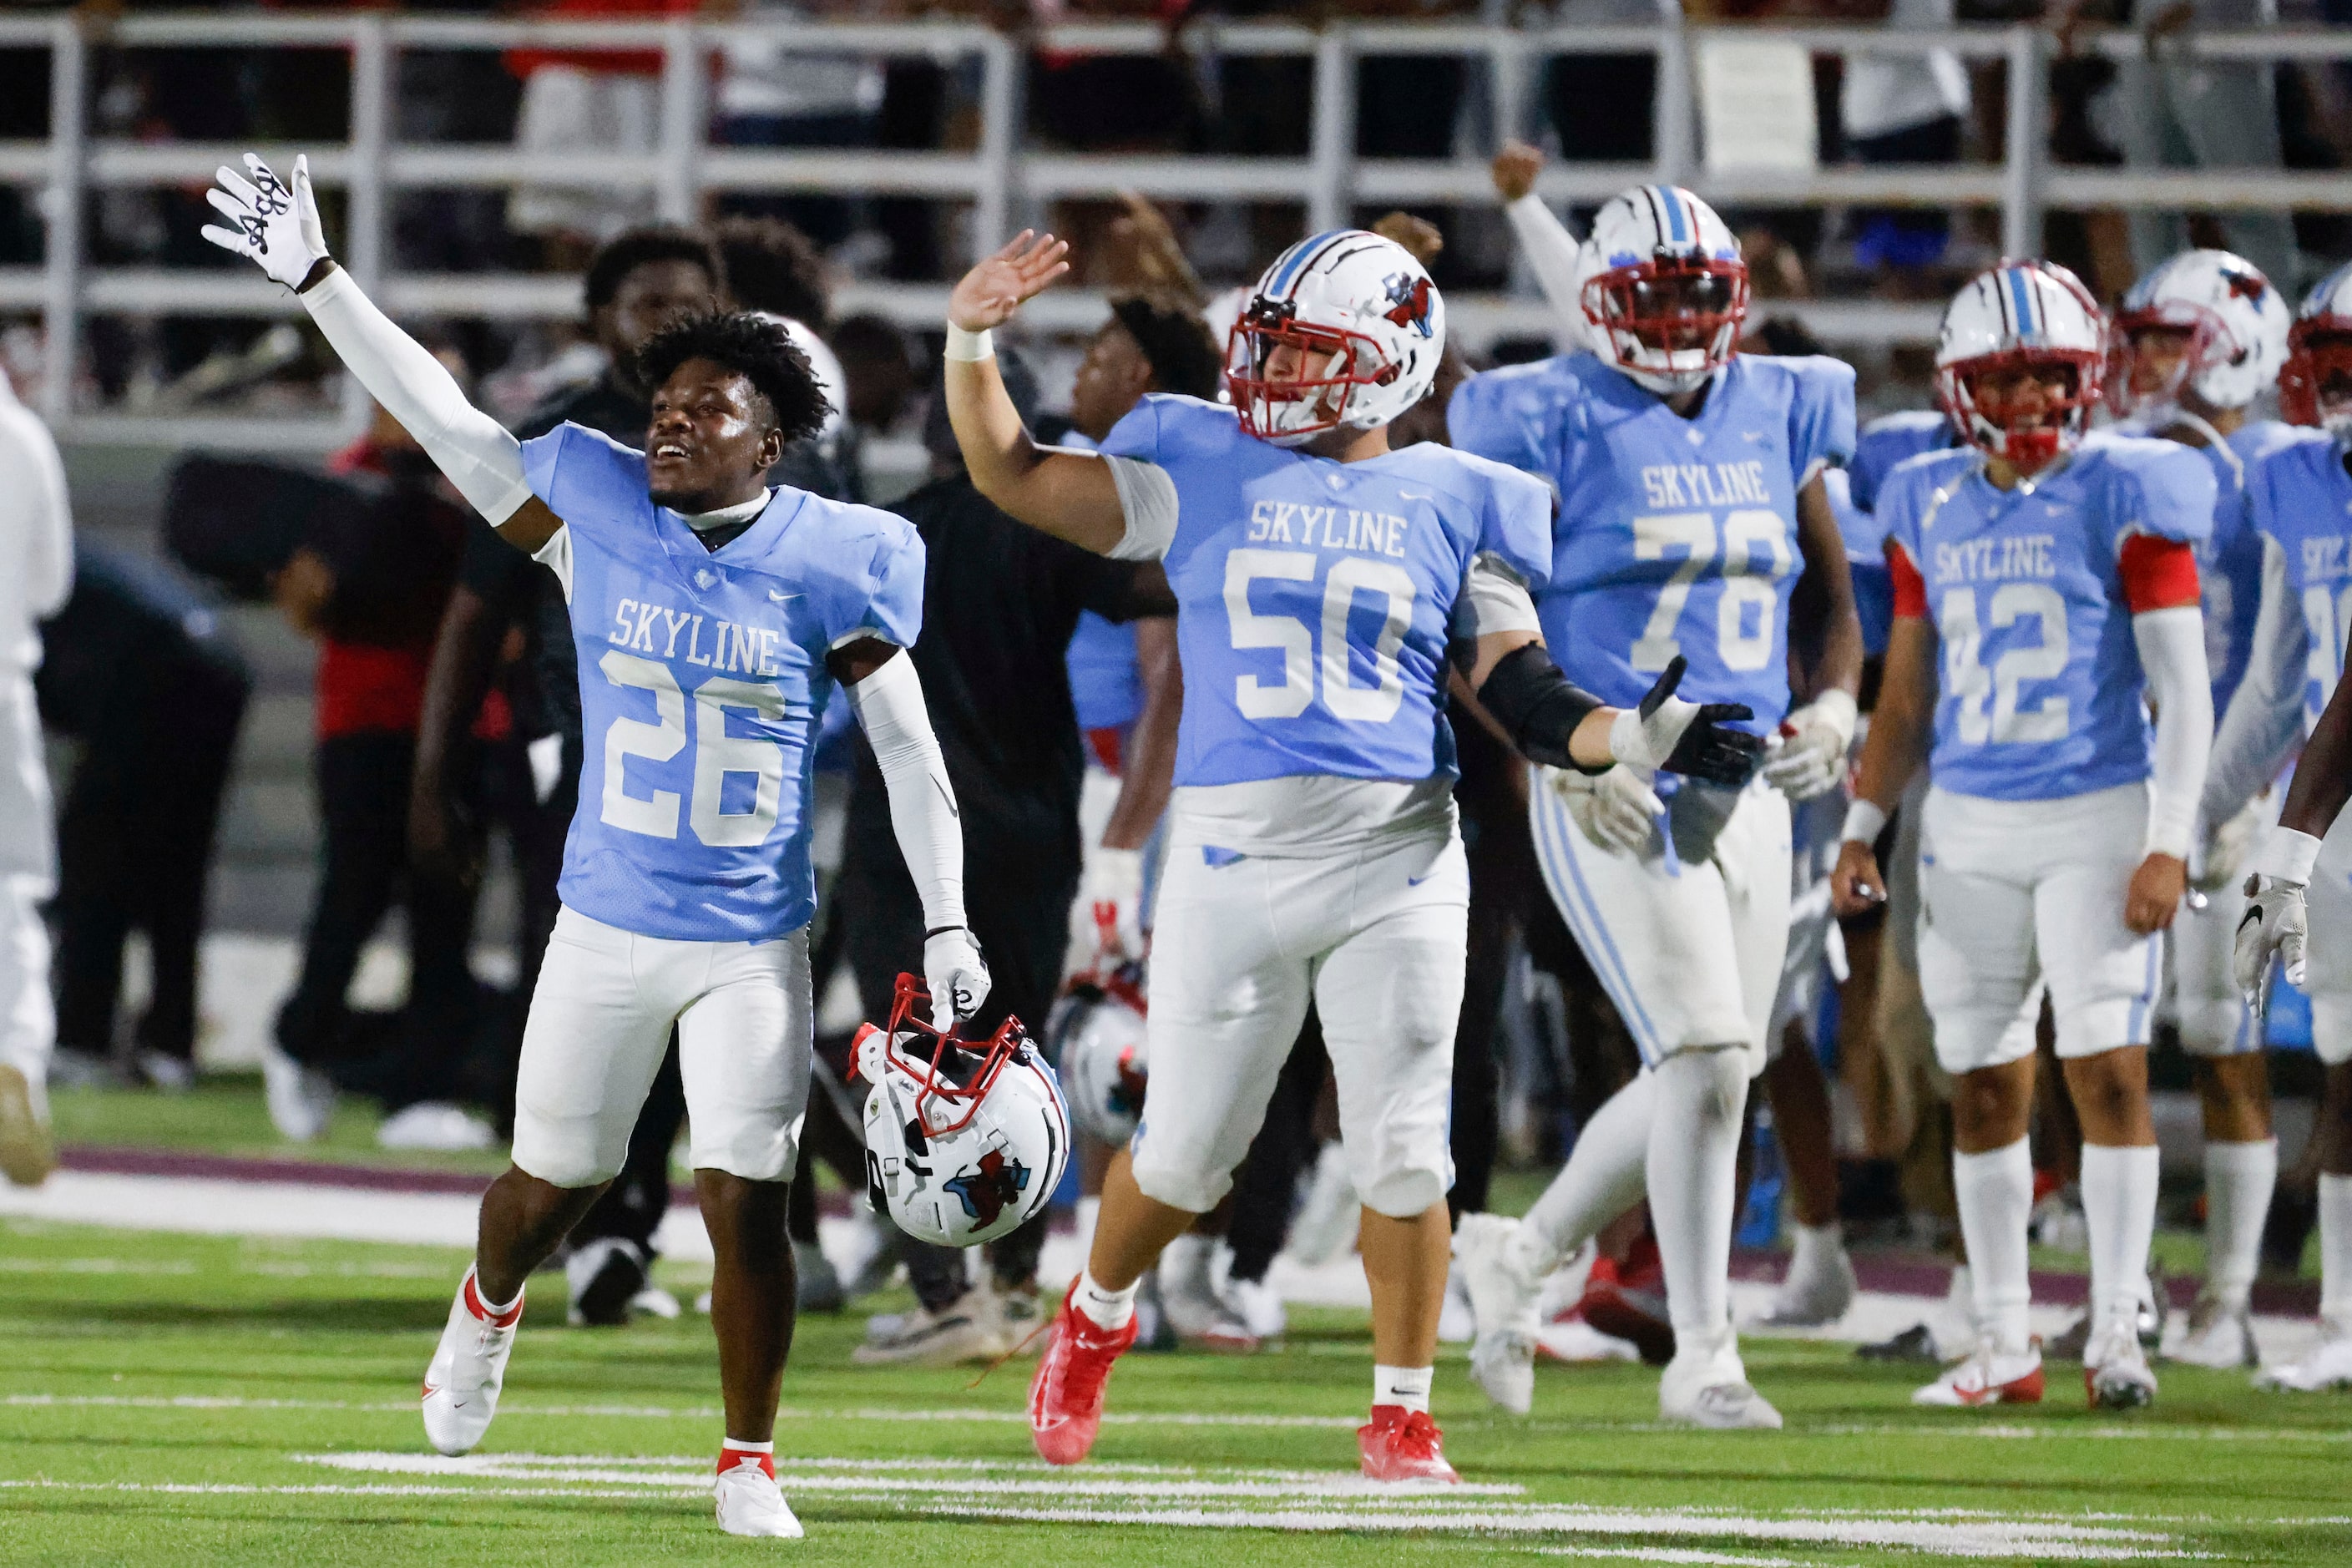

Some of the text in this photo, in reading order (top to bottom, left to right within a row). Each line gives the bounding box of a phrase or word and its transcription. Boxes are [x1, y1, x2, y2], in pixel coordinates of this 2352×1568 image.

[1249, 500, 1408, 559] SKYLINE
[1641, 460, 1771, 508] SKYLINE
[1631, 509, 1792, 672] 78
[1935, 534, 2056, 584] SKYLINE
[608, 598, 780, 677] SKYLINE
[1222, 548, 1416, 723] 50
[1941, 584, 2069, 746] 42
[599, 649, 786, 847] 26
